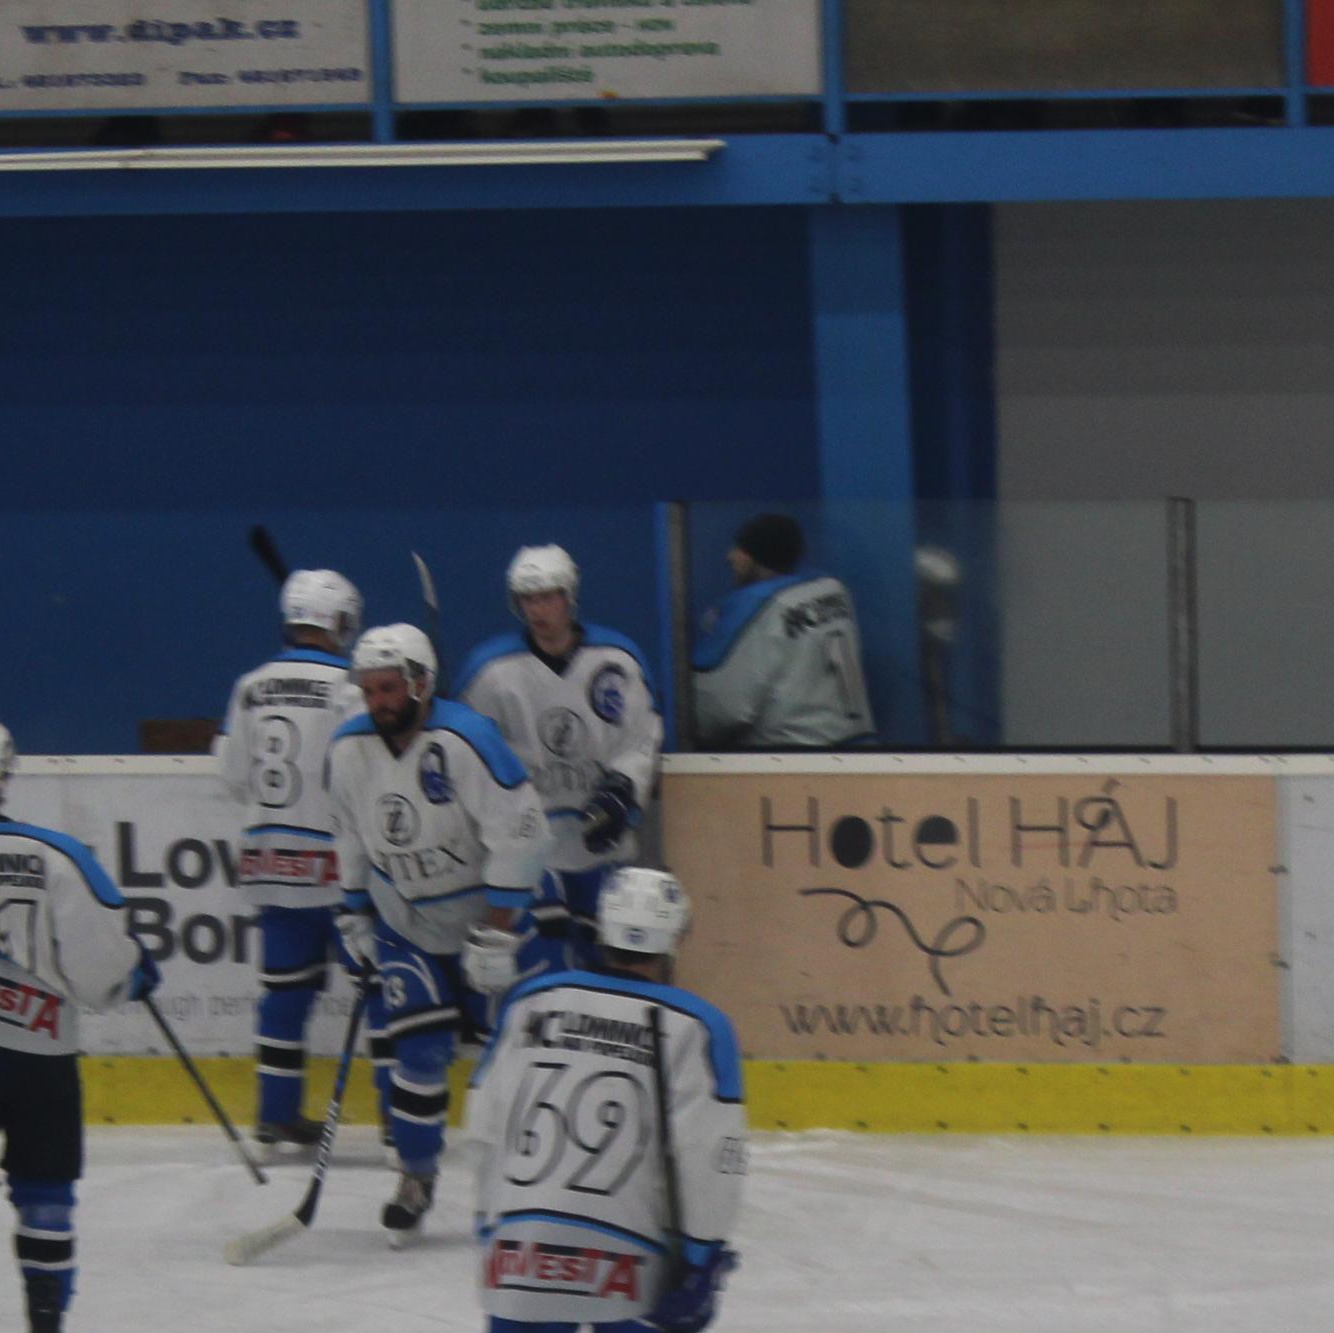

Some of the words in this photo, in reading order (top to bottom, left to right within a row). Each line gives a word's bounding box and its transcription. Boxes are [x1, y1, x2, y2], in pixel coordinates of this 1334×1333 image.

[249, 714, 304, 808] 8
[761, 796, 981, 869] Hotel
[953, 877, 1056, 914] Nová
[778, 995, 1169, 1047] www.hotelhaj.cz
